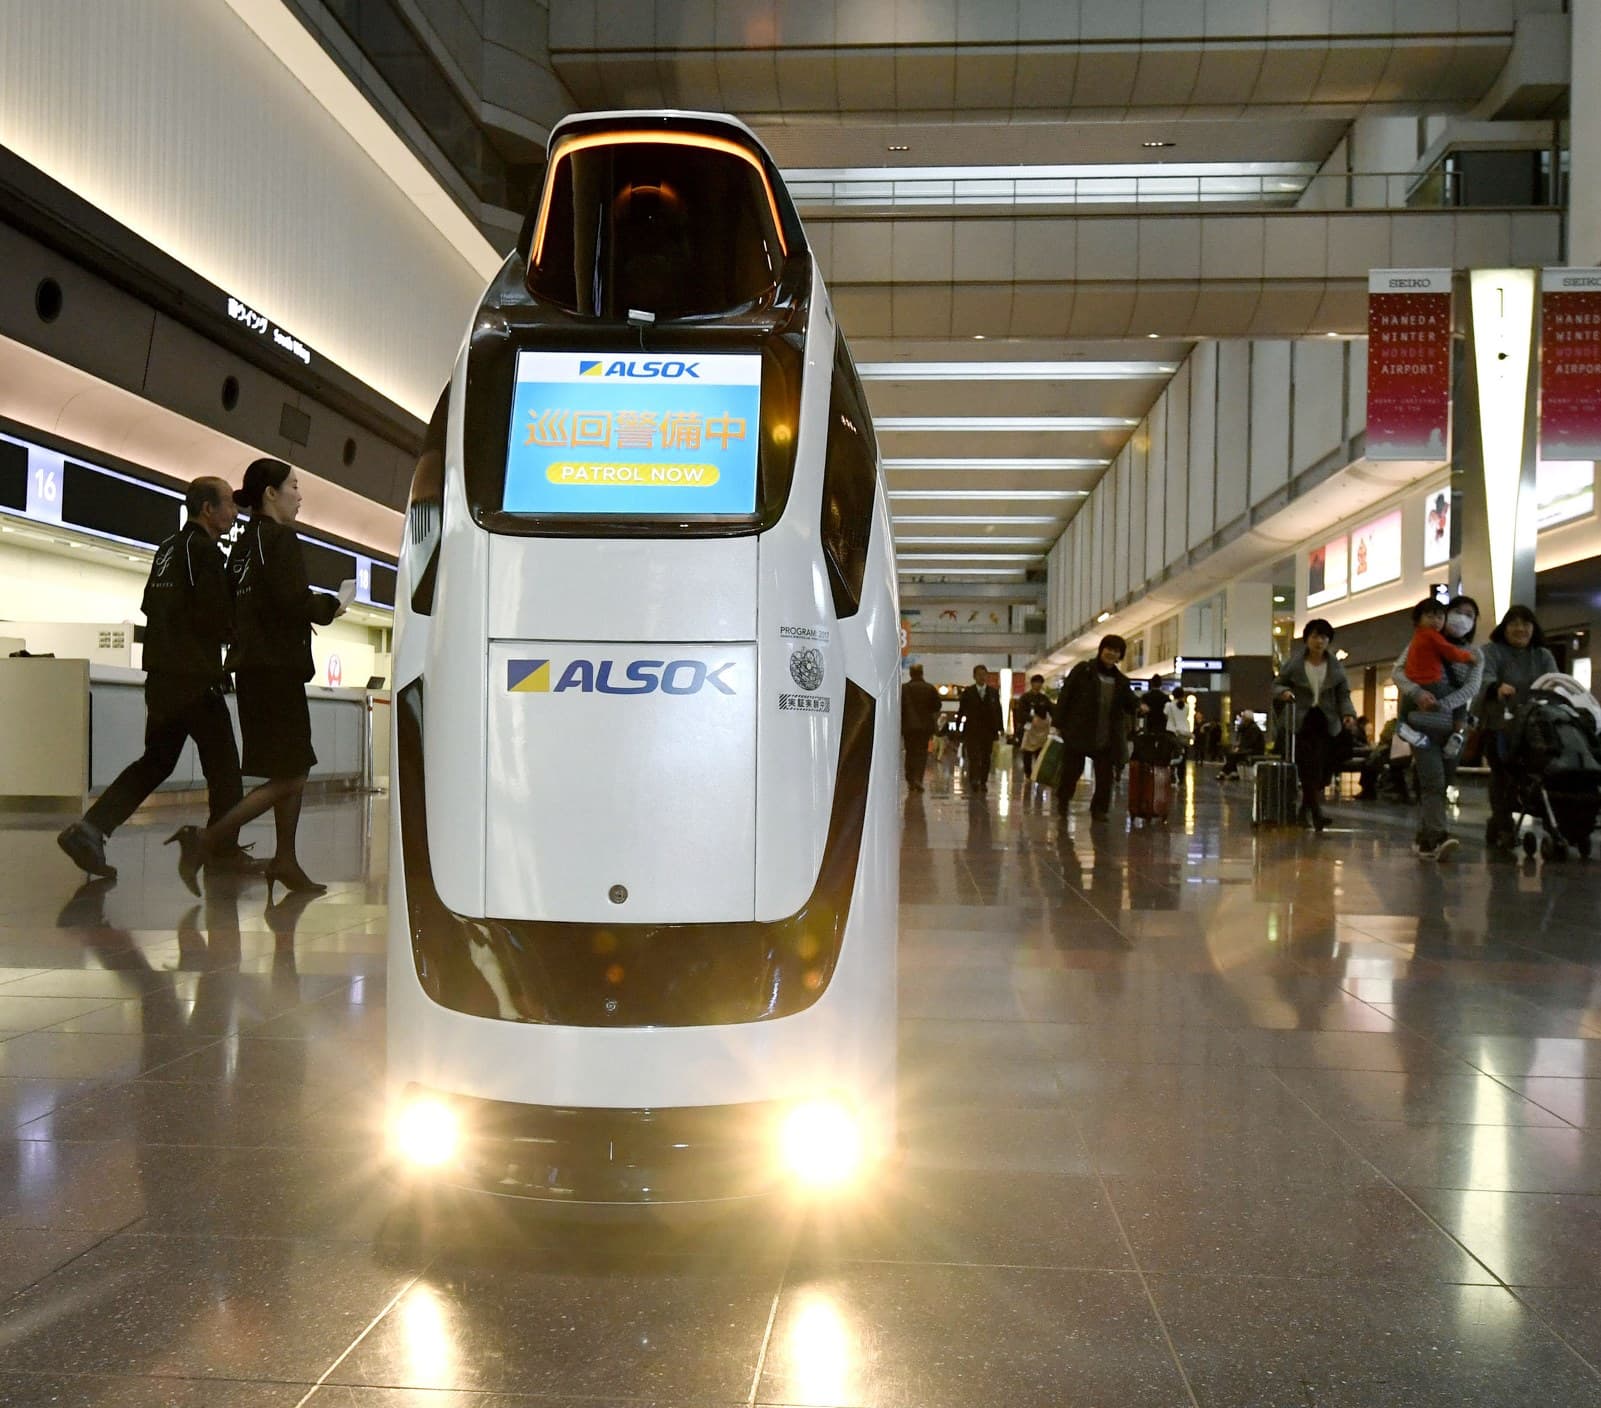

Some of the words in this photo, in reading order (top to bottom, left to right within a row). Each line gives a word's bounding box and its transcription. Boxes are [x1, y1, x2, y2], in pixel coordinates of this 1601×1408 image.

[1389, 278, 1431, 288] SEIKO
[1381, 315, 1436, 325] HANEDA
[1555, 314, 1601, 324] HANED
[1381, 331, 1436, 342] WINTER
[1555, 331, 1601, 341] WINTE
[604, 361, 700, 378] ALSOK
[1381, 364, 1434, 375] AIRPORT
[1555, 364, 1601, 374] AIRPOR
[524, 409, 747, 450] 巡回警備中
[561, 466, 643, 481] PATROL
[651, 468, 705, 482] NOW
[35, 469, 57, 502] 16
[359, 568, 369, 590] 18
[780, 626, 816, 637] PROGRAM
[552, 659, 737, 695] ALSOK
